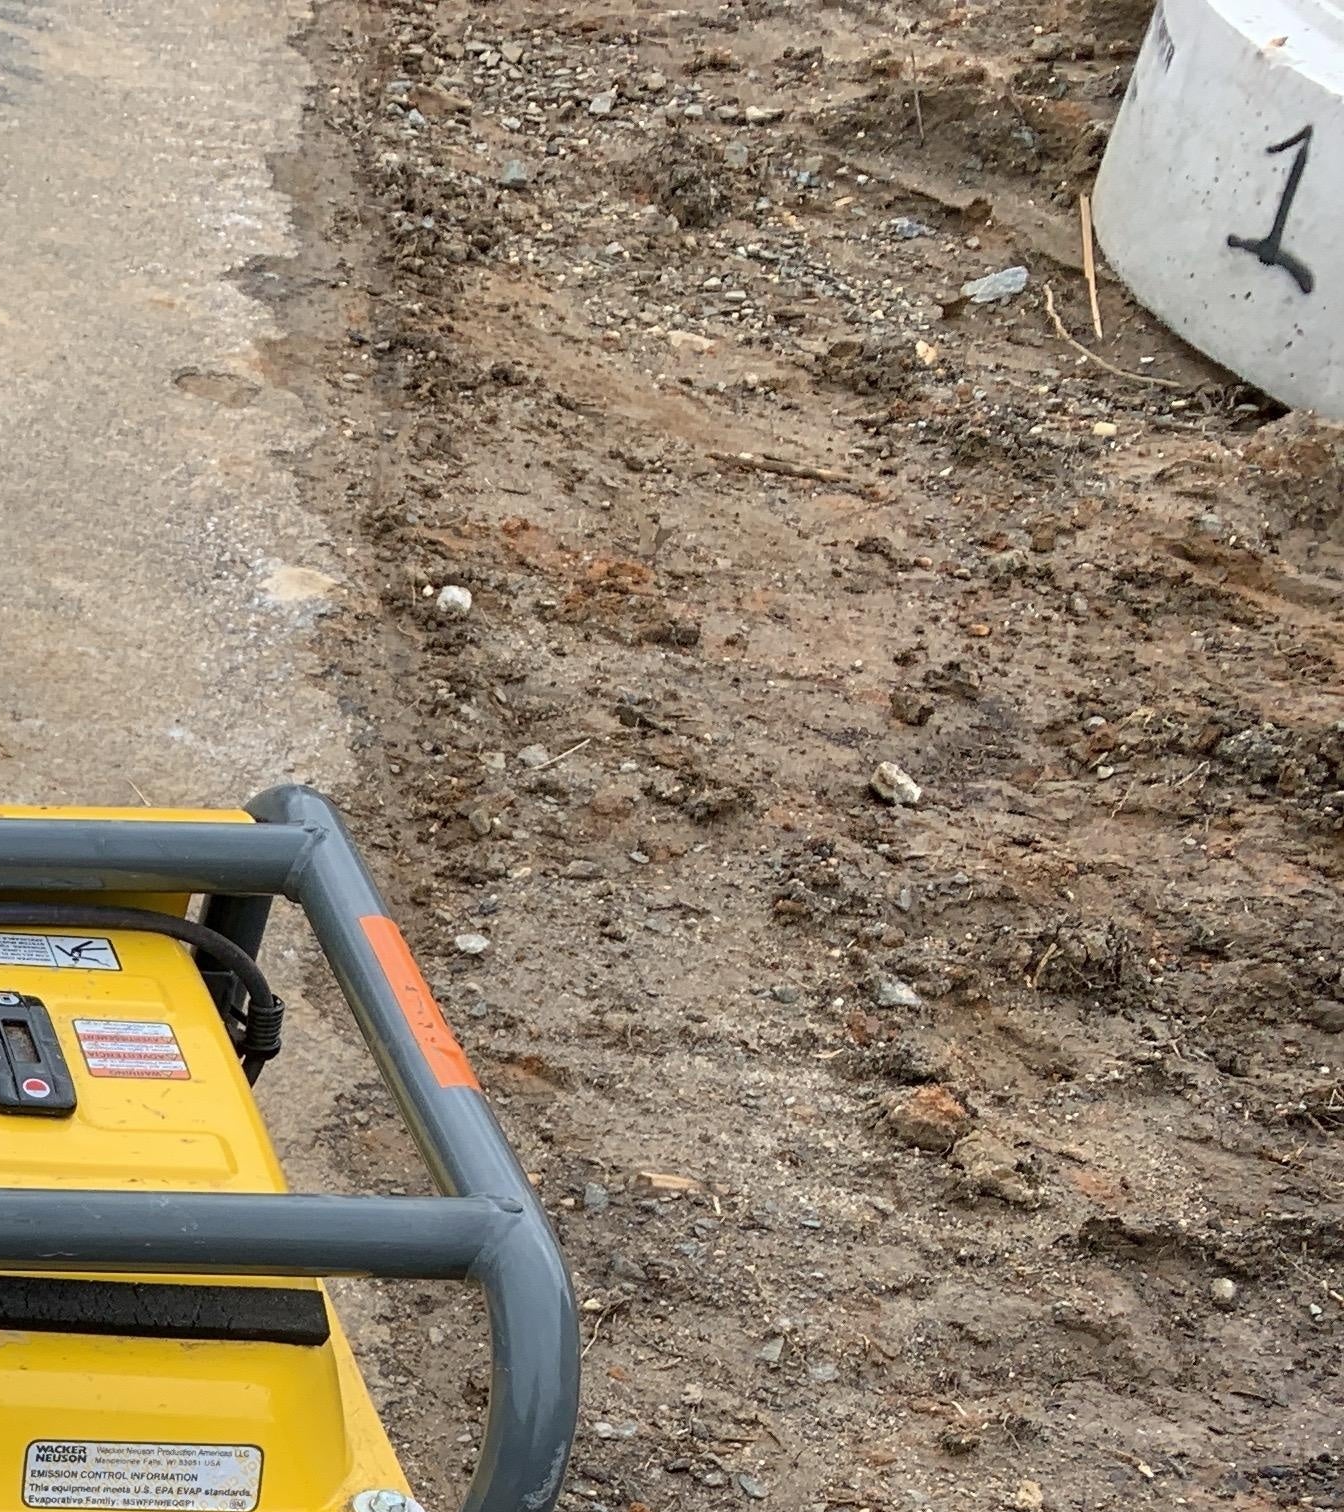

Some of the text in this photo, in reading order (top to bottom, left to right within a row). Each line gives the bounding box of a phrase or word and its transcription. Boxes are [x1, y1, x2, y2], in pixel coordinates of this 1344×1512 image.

[1227, 125, 1316, 294] 1
[36, 1445, 87, 1454] WACKER
[96, 1447, 250, 1458] Wacker Neuson Production Americas LLC
[36, 1454, 87, 1463] NEUSON
[30, 1470, 198, 1482] EMISSION CONTROL INFORMATION
[29, 1484, 49, 1492] This
[51, 1484, 100, 1494] equipment
[103, 1485, 130, 1494] meets
[134, 1485, 153, 1494] U.S.
[155, 1486, 174, 1495] EPA
[177, 1487, 202, 1496] EVAP
[29, 1495, 82, 1505] Evaporative
